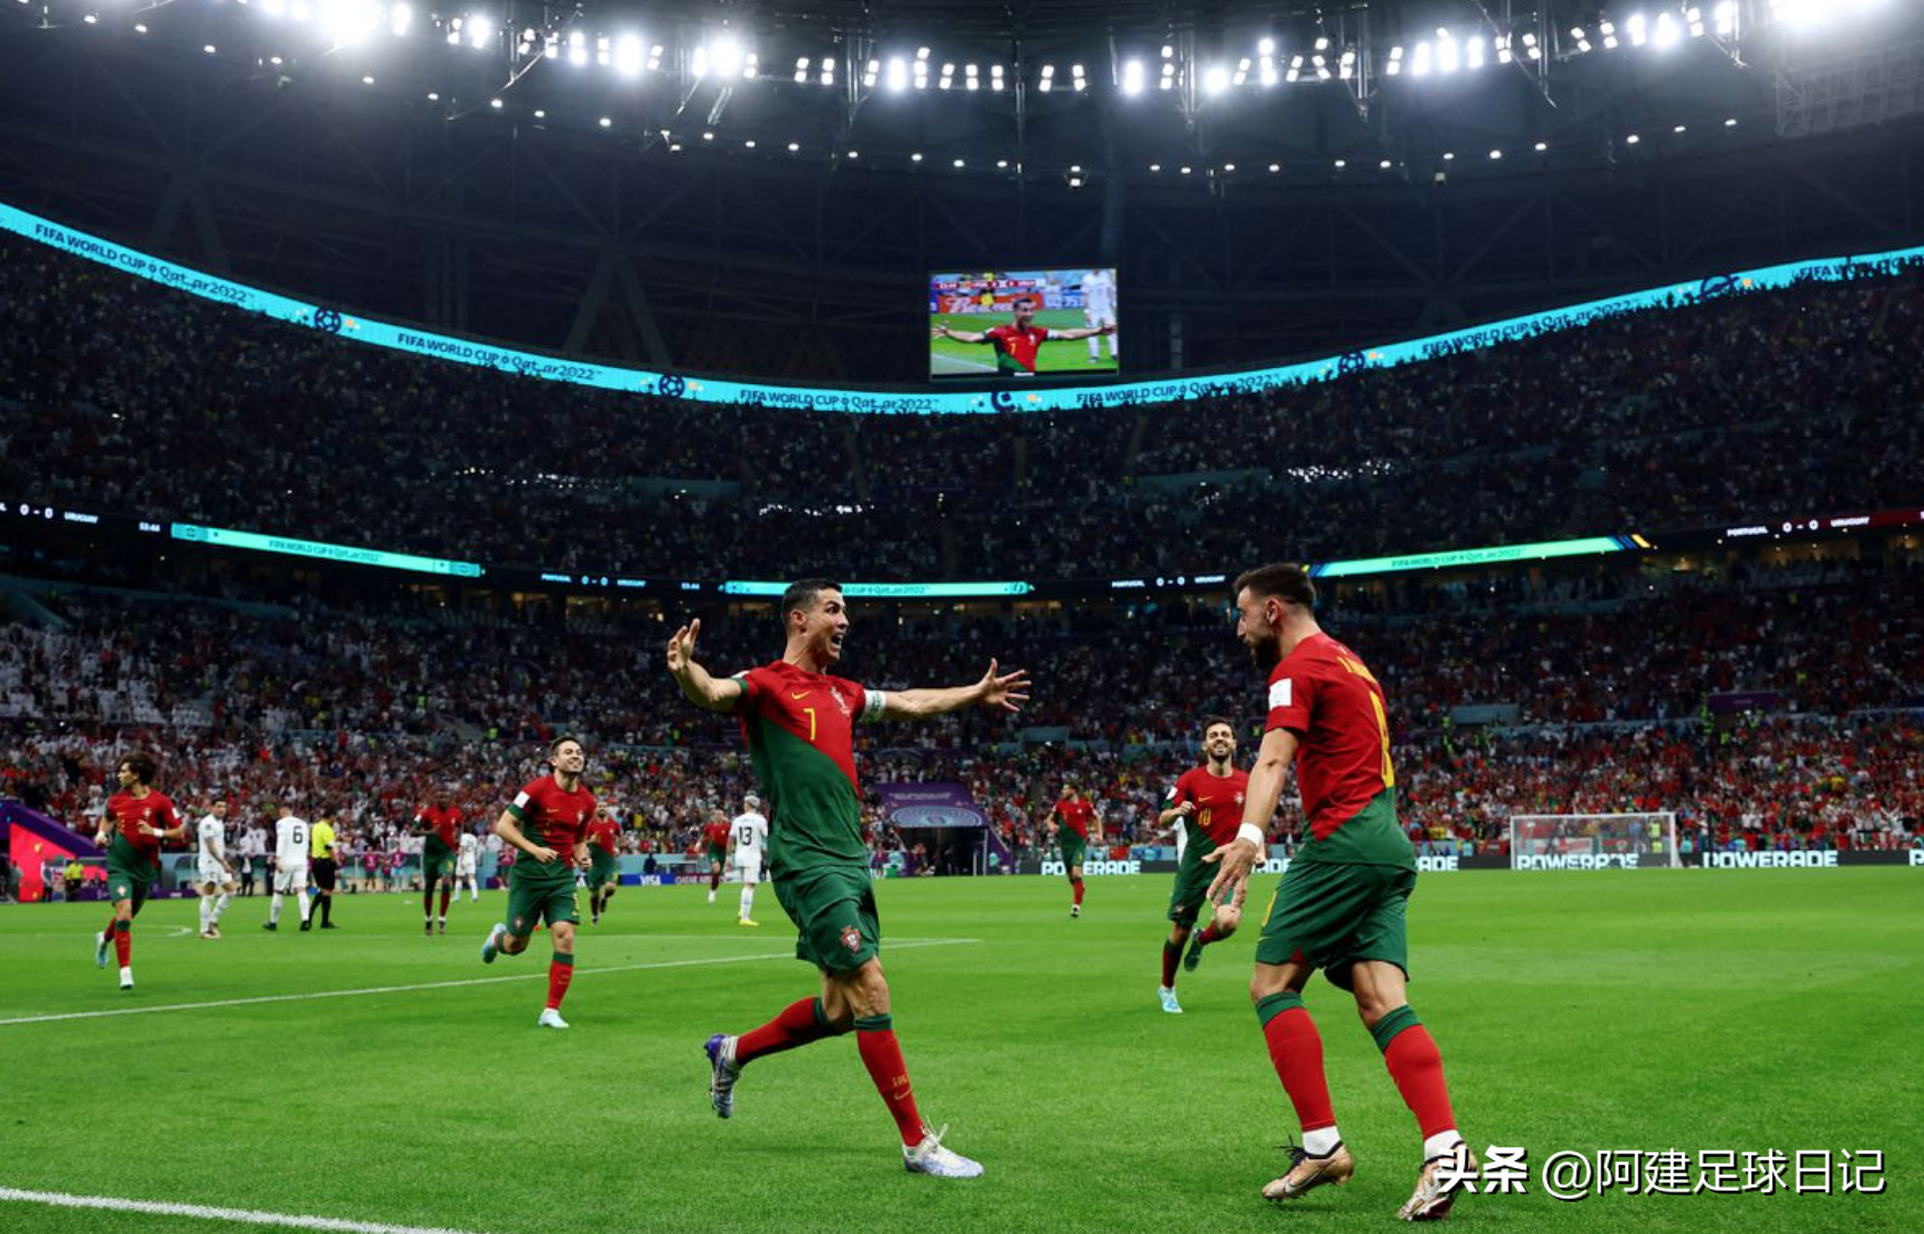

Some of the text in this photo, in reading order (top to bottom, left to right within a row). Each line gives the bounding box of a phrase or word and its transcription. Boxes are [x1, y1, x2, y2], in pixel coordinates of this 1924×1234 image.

[35, 223, 65, 243] FIFA
[67, 235, 118, 260] WORLD
[119, 253, 146, 269] CUP
[398, 333, 425, 349] FIFA
[427, 340, 473, 358] WORLD
[475, 349, 500, 362] CUP
[740, 389, 767, 401] FIFA
[768, 391, 814, 405] WORLD
[816, 395, 840, 405] CUP
[1076, 393, 1103, 404] FIFA
[1105, 388, 1151, 401] WORLD
[1153, 385, 1177, 397] CUP
[20, 503, 30, 516] 0
[1727, 526, 1769, 537] PORTUGAL
[1782, 521, 1793, 533] 0
[1808, 519, 1819, 531] 0
[803, 707, 816, 741] 7
[1198, 808, 1211, 827] 10
[293, 825, 303, 844] 6
[738, 826, 753, 846] 13
[1041, 860, 1141, 876] POERADE
[1703, 850, 1838, 868] POWERADE
